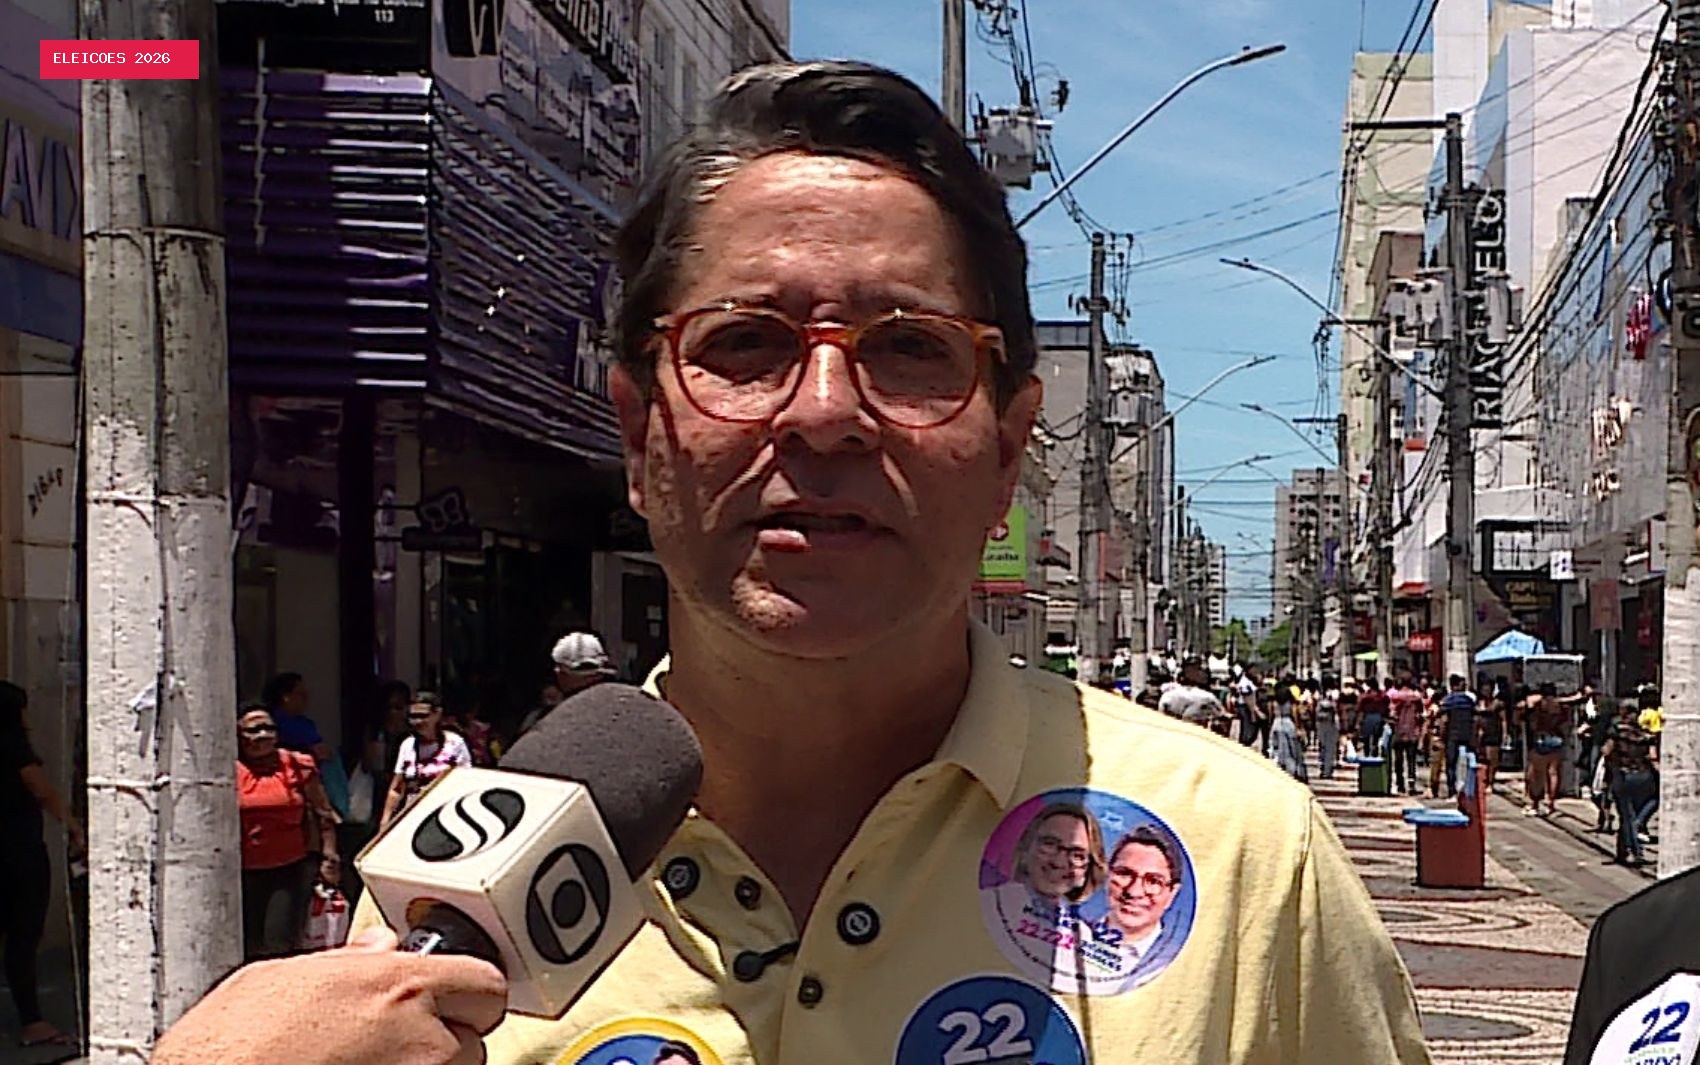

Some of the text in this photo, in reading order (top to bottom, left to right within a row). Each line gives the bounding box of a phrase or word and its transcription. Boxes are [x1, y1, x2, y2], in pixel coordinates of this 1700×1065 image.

[1474, 195, 1502, 421] RIACELO
[938, 1002, 1033, 1064] 22
[1628, 1001, 1690, 1054] 22
